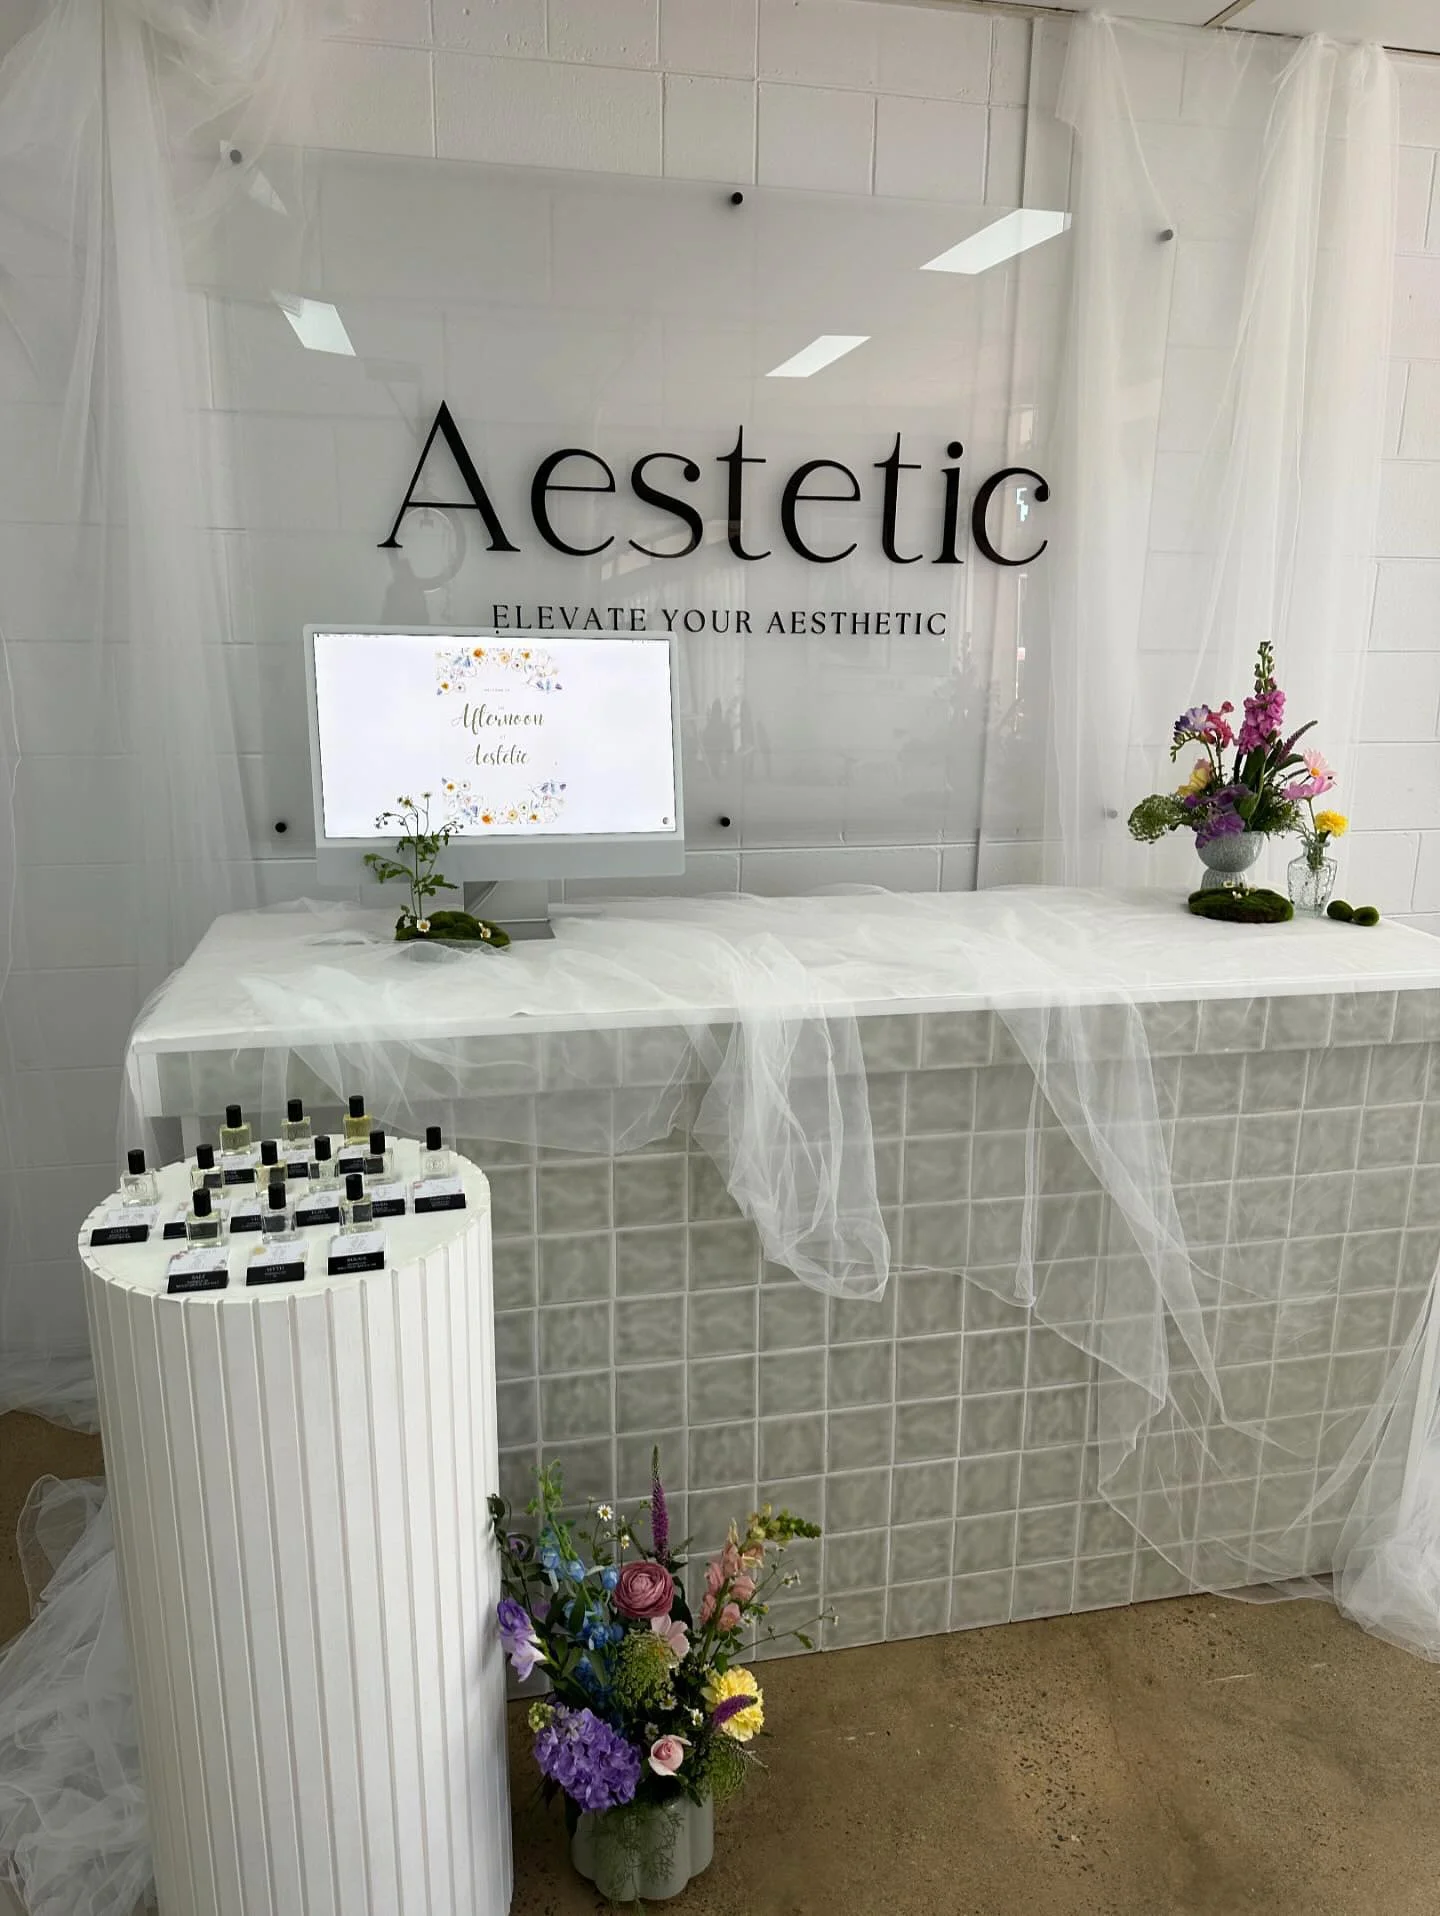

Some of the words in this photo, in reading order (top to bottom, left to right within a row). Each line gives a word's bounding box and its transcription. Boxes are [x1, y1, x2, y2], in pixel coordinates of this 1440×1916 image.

[376, 400, 1051, 566] Aestetic
[492, 604, 647, 632] ELEVATE
[661, 608, 752, 635] YOUR
[766, 611, 948, 637] AESTHETIC
[451, 703, 544, 735] Afternoon
